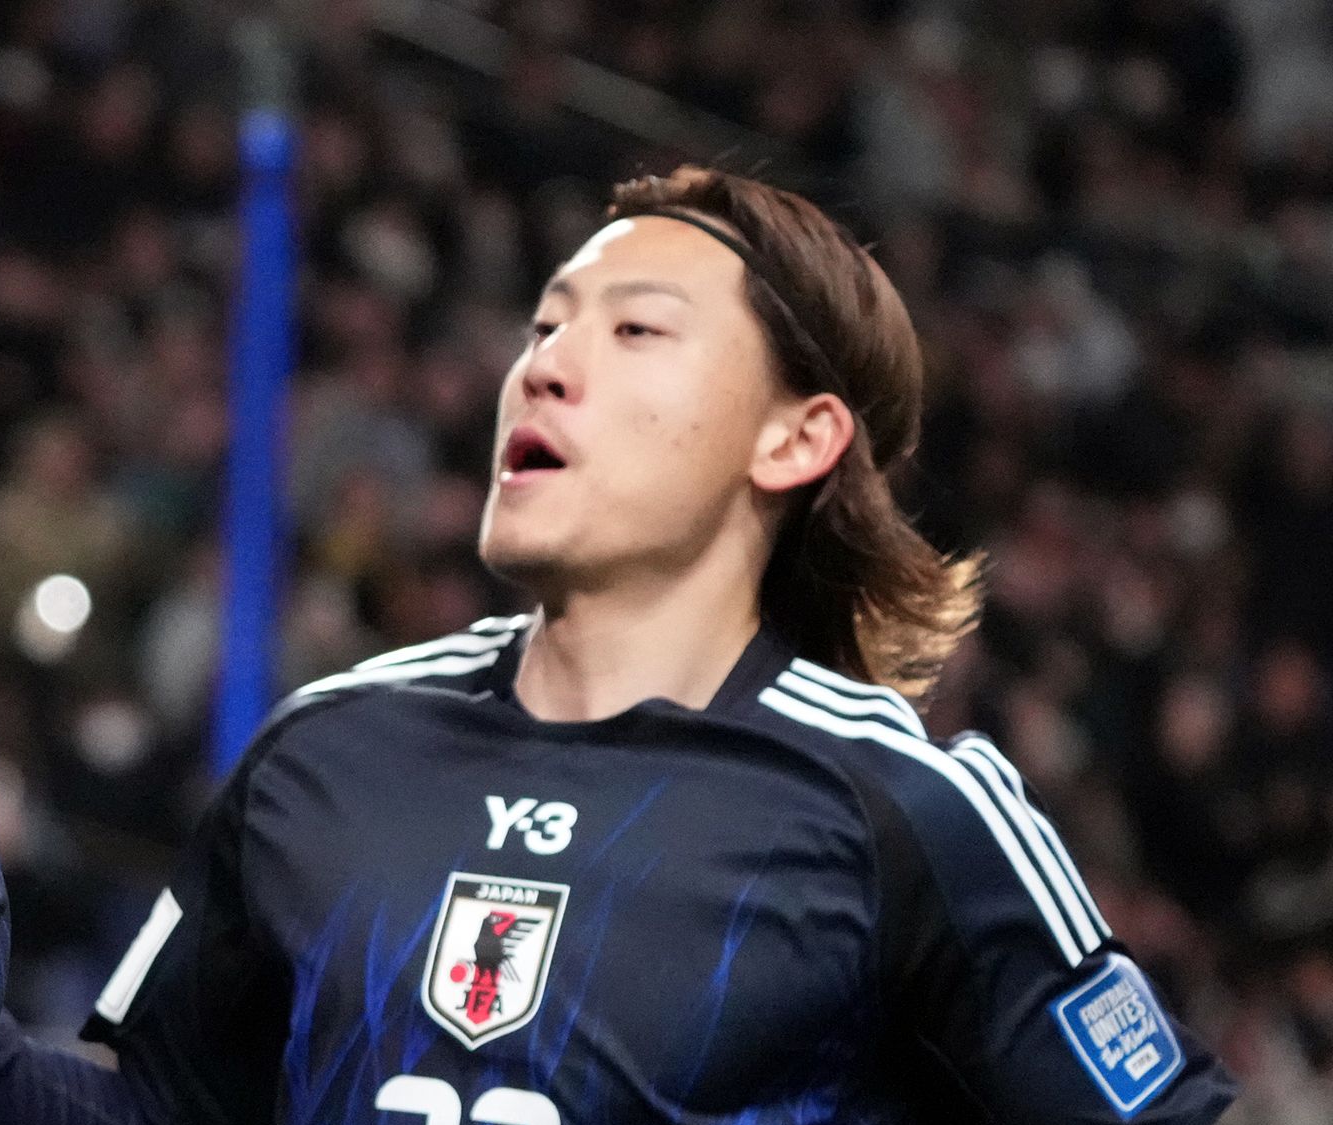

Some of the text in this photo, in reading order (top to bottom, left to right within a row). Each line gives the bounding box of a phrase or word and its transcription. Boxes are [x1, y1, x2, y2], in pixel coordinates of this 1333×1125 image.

[485, 795, 578, 855] Y-3
[475, 884, 539, 904] JAPAN
[454, 989, 503, 1015] JFA
